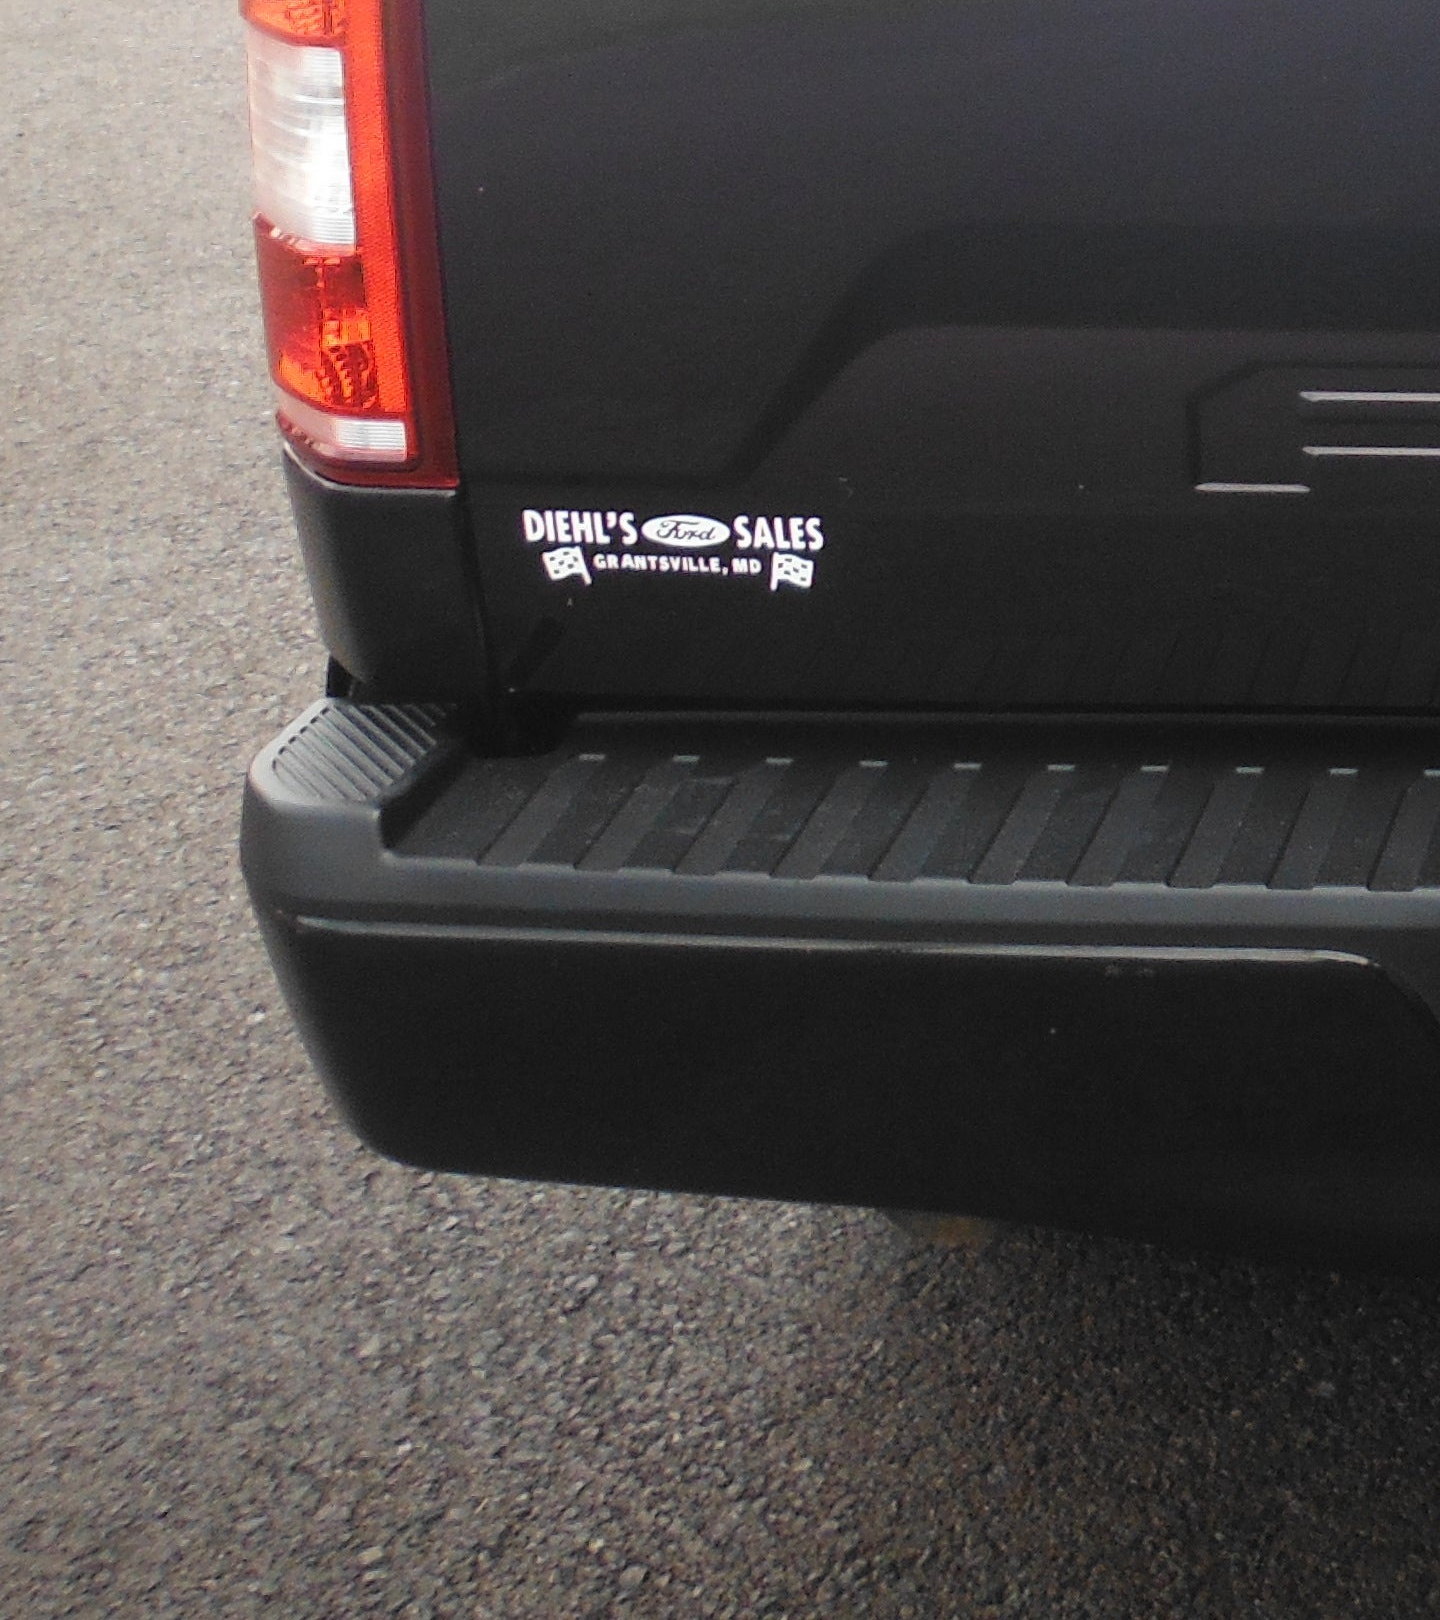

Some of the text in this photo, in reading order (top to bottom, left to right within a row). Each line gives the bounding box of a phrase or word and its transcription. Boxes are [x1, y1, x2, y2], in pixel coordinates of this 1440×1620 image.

[522, 508, 824, 550] DIEHL'S Ford SALES
[592, 553, 763, 575] GRANTSVILLE, MD
